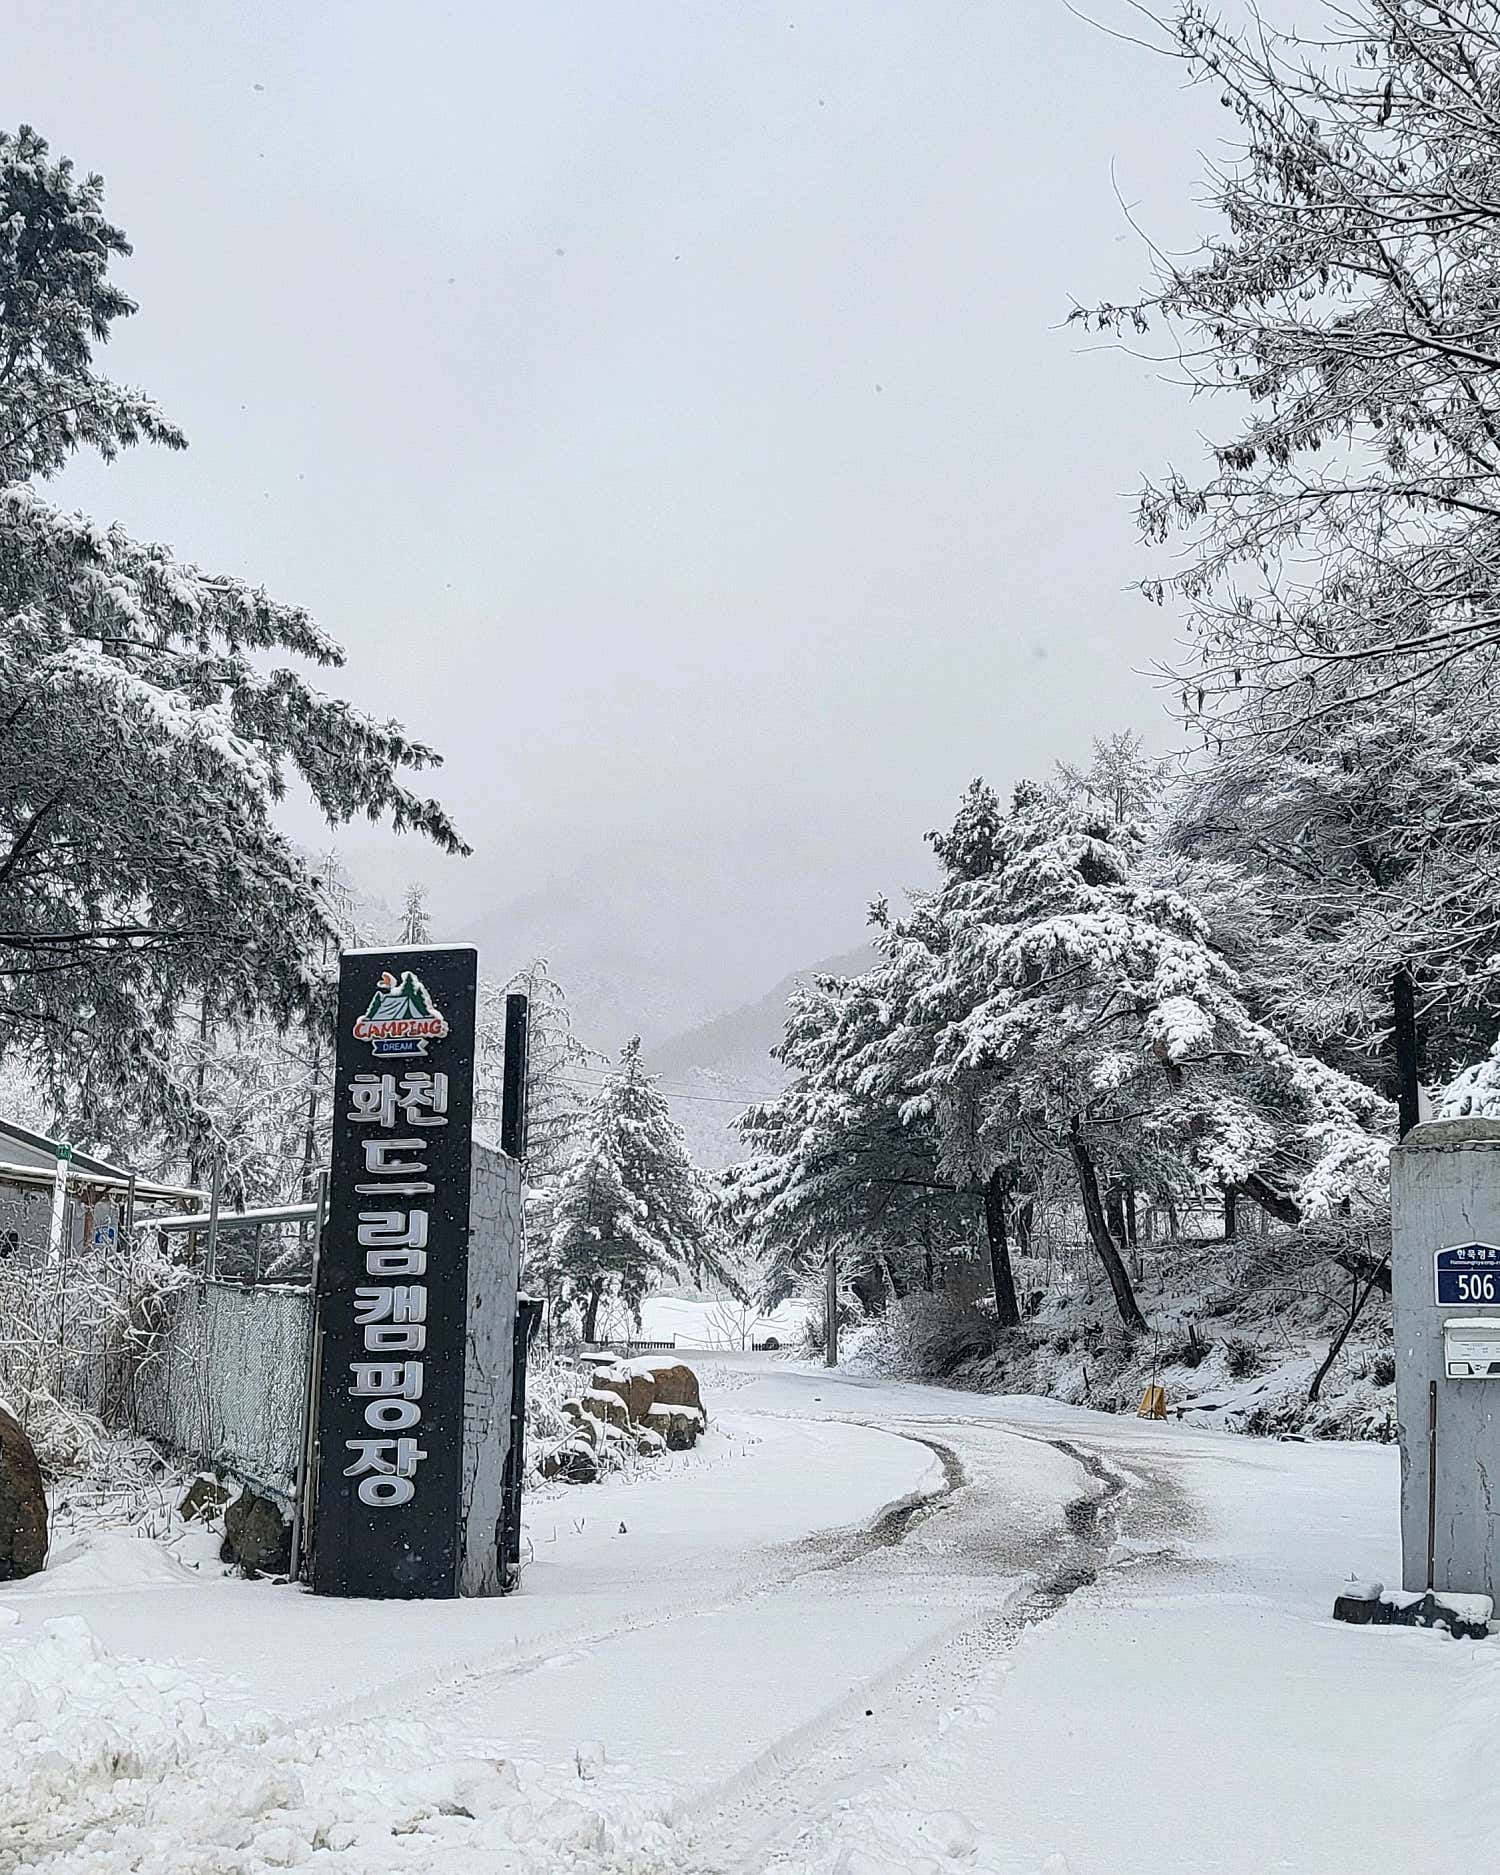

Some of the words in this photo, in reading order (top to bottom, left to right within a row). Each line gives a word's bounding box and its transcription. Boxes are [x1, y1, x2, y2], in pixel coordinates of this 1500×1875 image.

[354, 1020, 442, 1039] CAMPING
[382, 1042, 413, 1051] DREAM
[347, 1072, 449, 1128] 화천
[1458, 1274, 1495, 1300] 506
[343, 1138, 435, 1507] 드림캠핑장
